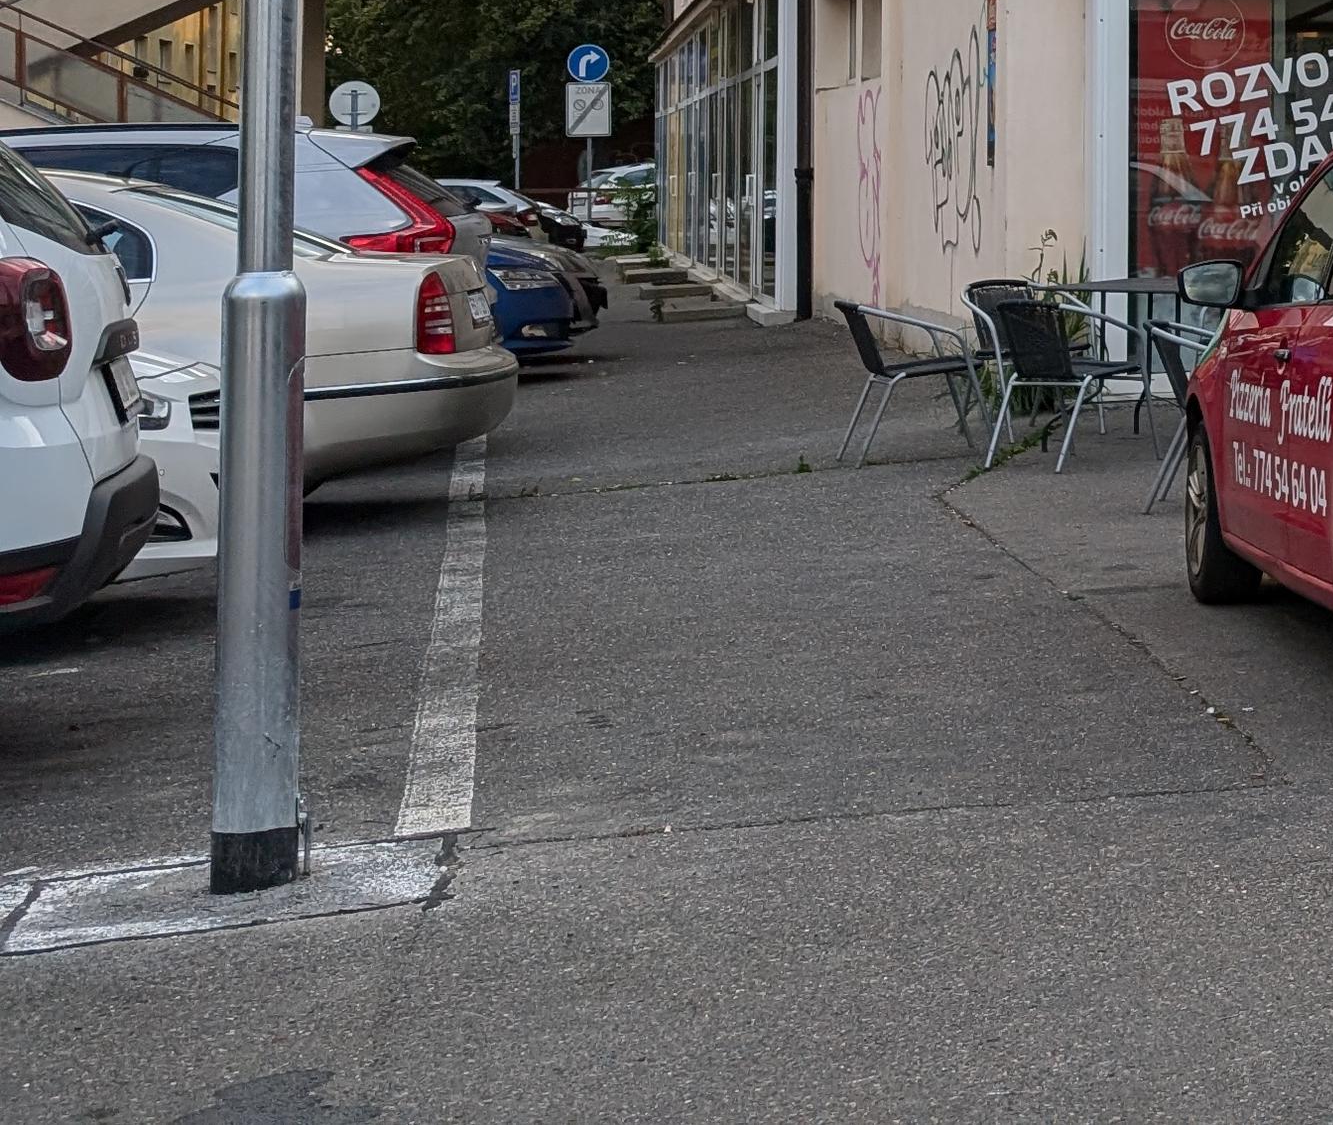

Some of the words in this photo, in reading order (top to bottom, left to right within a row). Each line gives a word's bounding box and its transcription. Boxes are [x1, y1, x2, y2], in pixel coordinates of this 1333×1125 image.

[1170, 17, 1242, 41] Coca-Cola
[1190, 107, 1279, 156] 774
[1239, 201, 1264, 219] Při
[1226, 369, 1271, 427] Pizzeria
[1277, 376, 1333, 445] Fratelli
[1232, 441, 1250, 487] Tel.:
[1253, 449, 1272, 497] 774
[1274, 455, 1289, 503] 54
[1291, 461, 1307, 510] 64
[1310, 466, 1327, 516] 04
